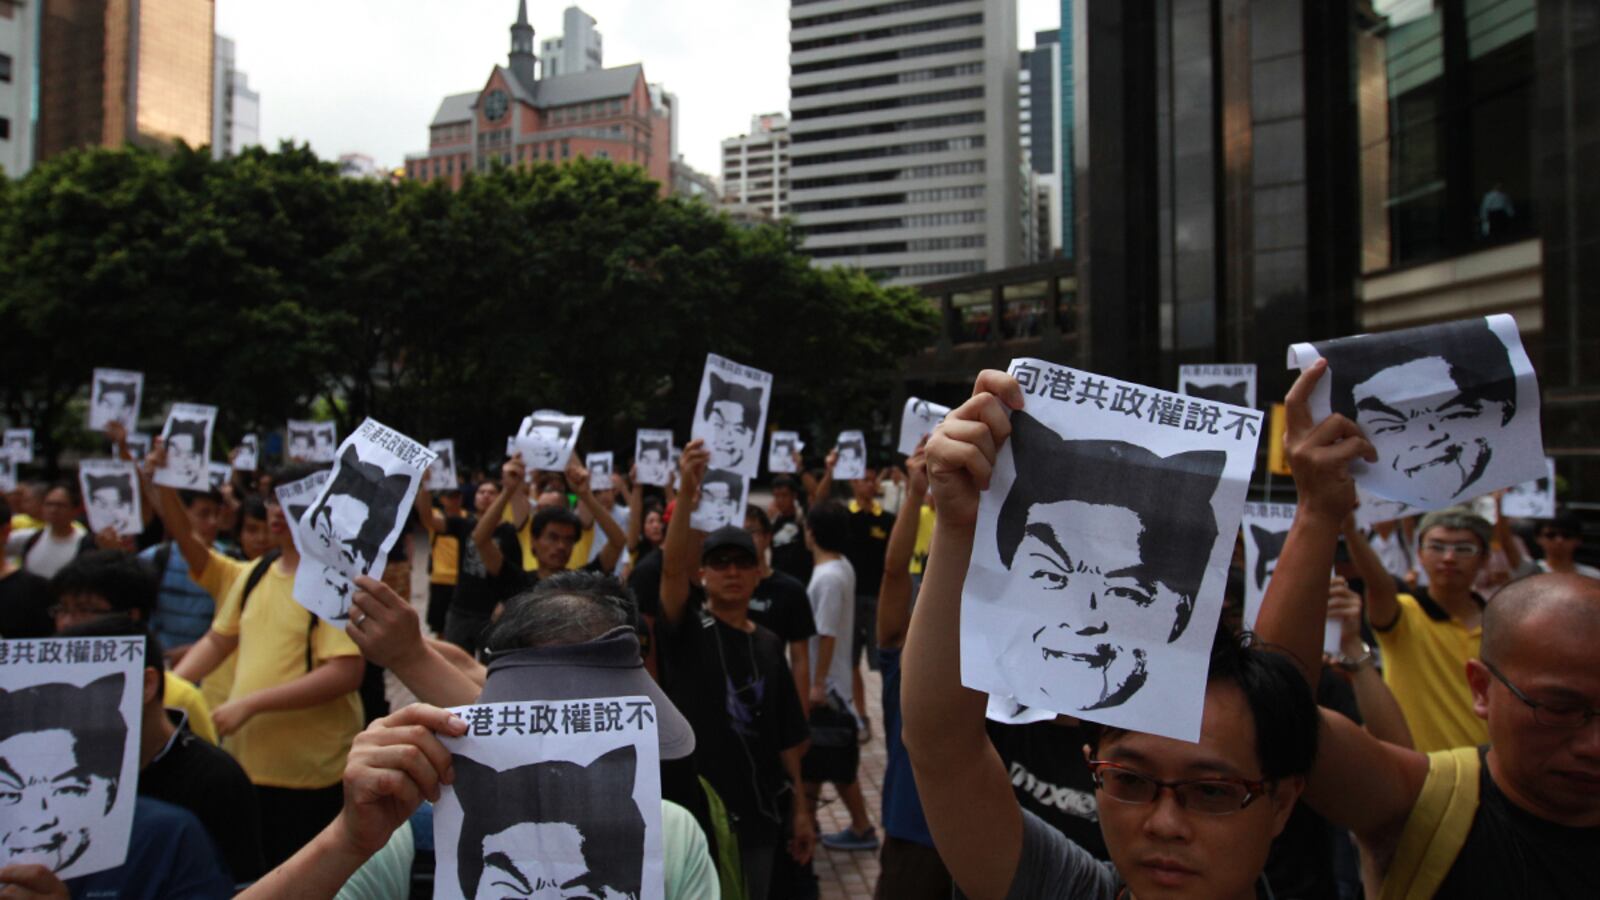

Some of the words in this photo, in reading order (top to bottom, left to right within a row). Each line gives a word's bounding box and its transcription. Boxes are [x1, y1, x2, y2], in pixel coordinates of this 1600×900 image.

[1010, 361, 1260, 441] 向港共政權說不
[362, 422, 434, 469] 向港共政權說不
[453, 701, 655, 737] 港共政權說不
